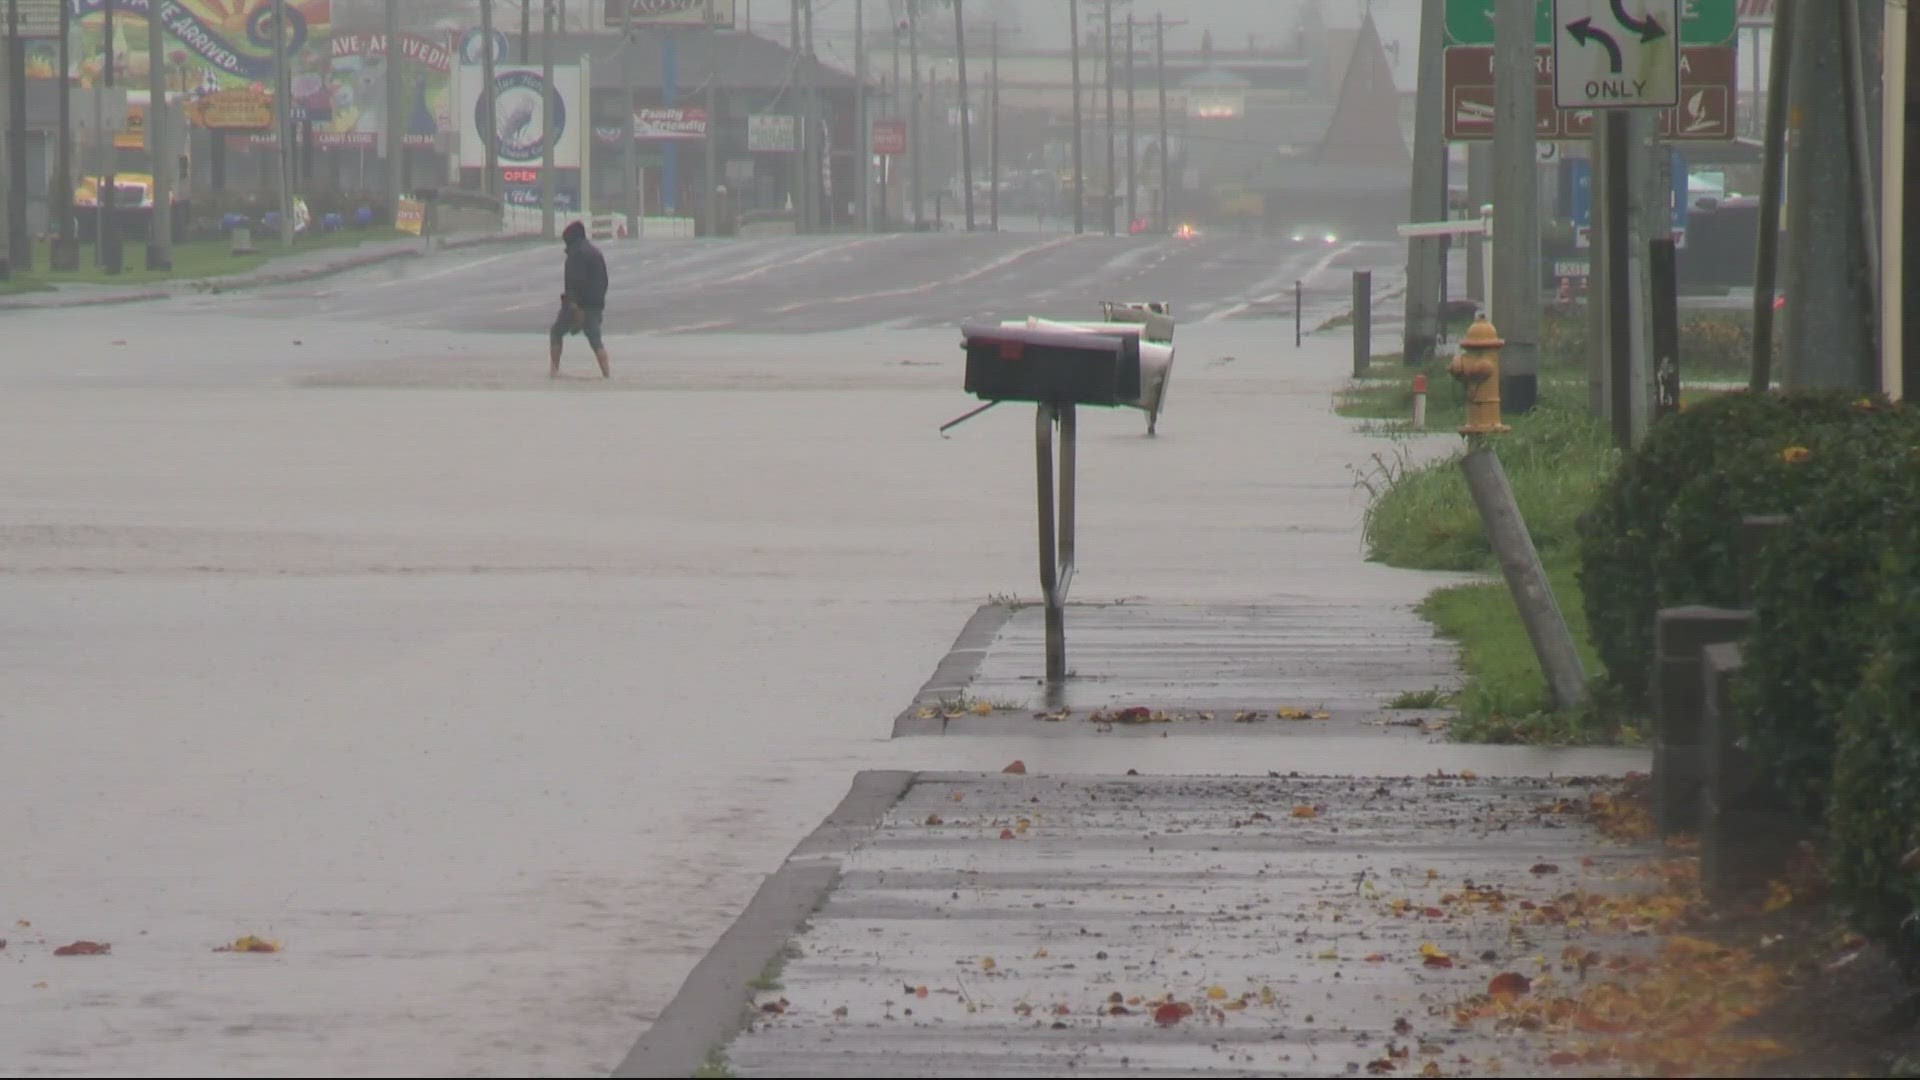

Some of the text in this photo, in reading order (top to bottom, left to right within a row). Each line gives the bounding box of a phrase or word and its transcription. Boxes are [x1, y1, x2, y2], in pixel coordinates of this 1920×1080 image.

[331, 35, 360, 55] AVE
[1585, 80, 1647, 98] ONLY
[640, 108, 684, 121] Family
[652, 119, 707, 133] Friendly
[504, 170, 537, 181] OPEN
